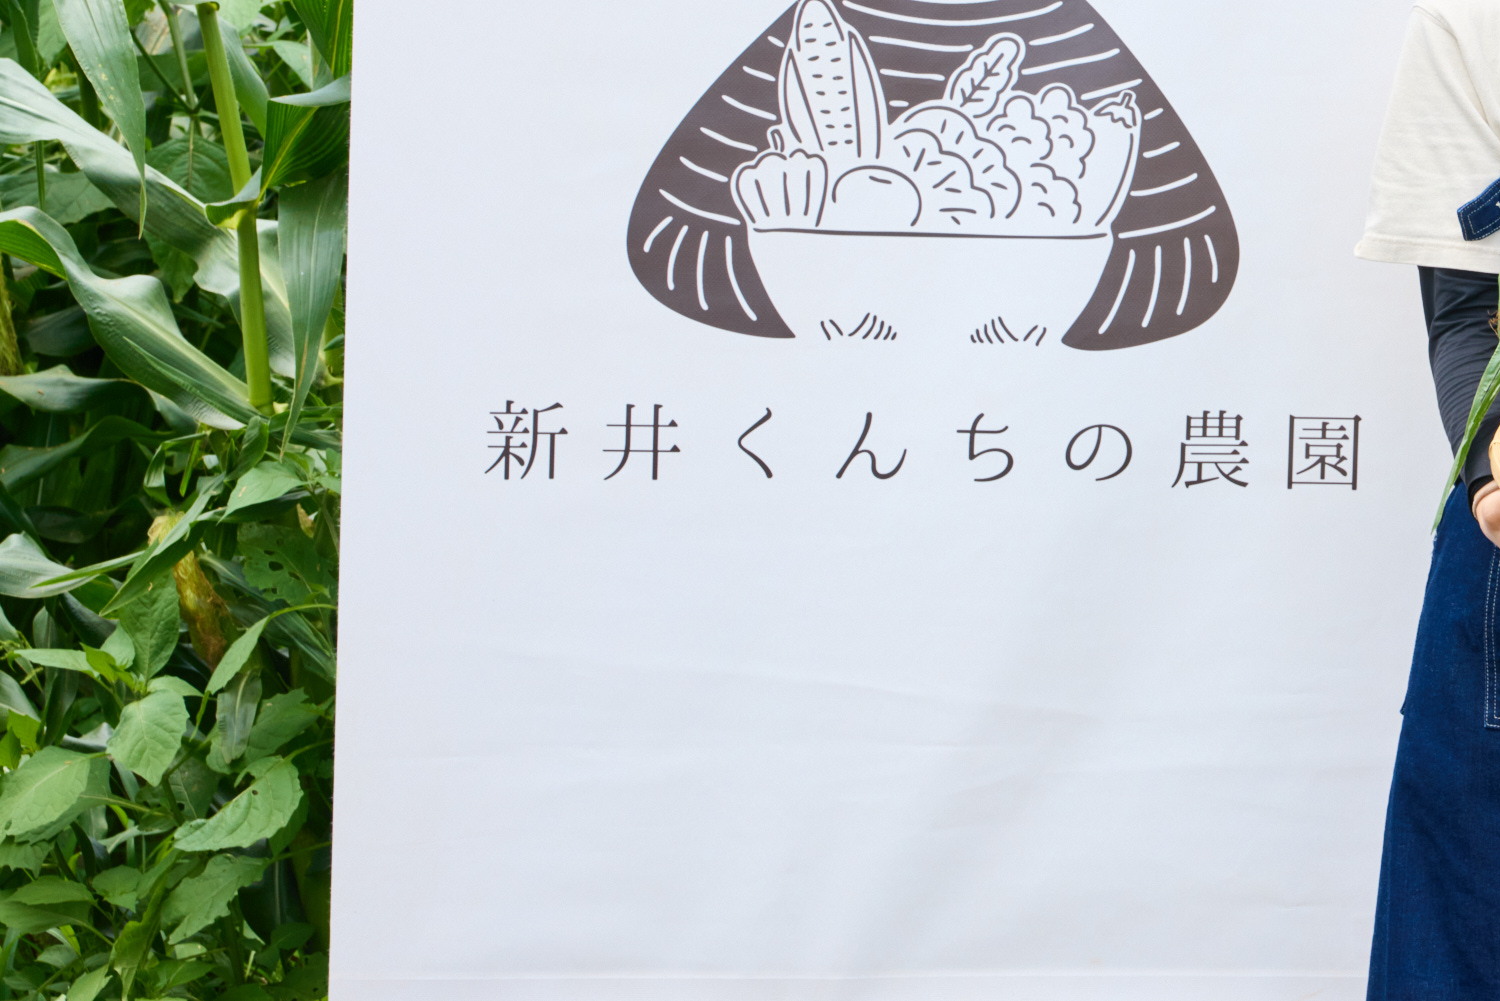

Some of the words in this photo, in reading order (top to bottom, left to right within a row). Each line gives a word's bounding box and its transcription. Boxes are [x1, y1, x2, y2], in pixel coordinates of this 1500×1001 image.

[484, 399, 1363, 491] 新井くんちの農園
